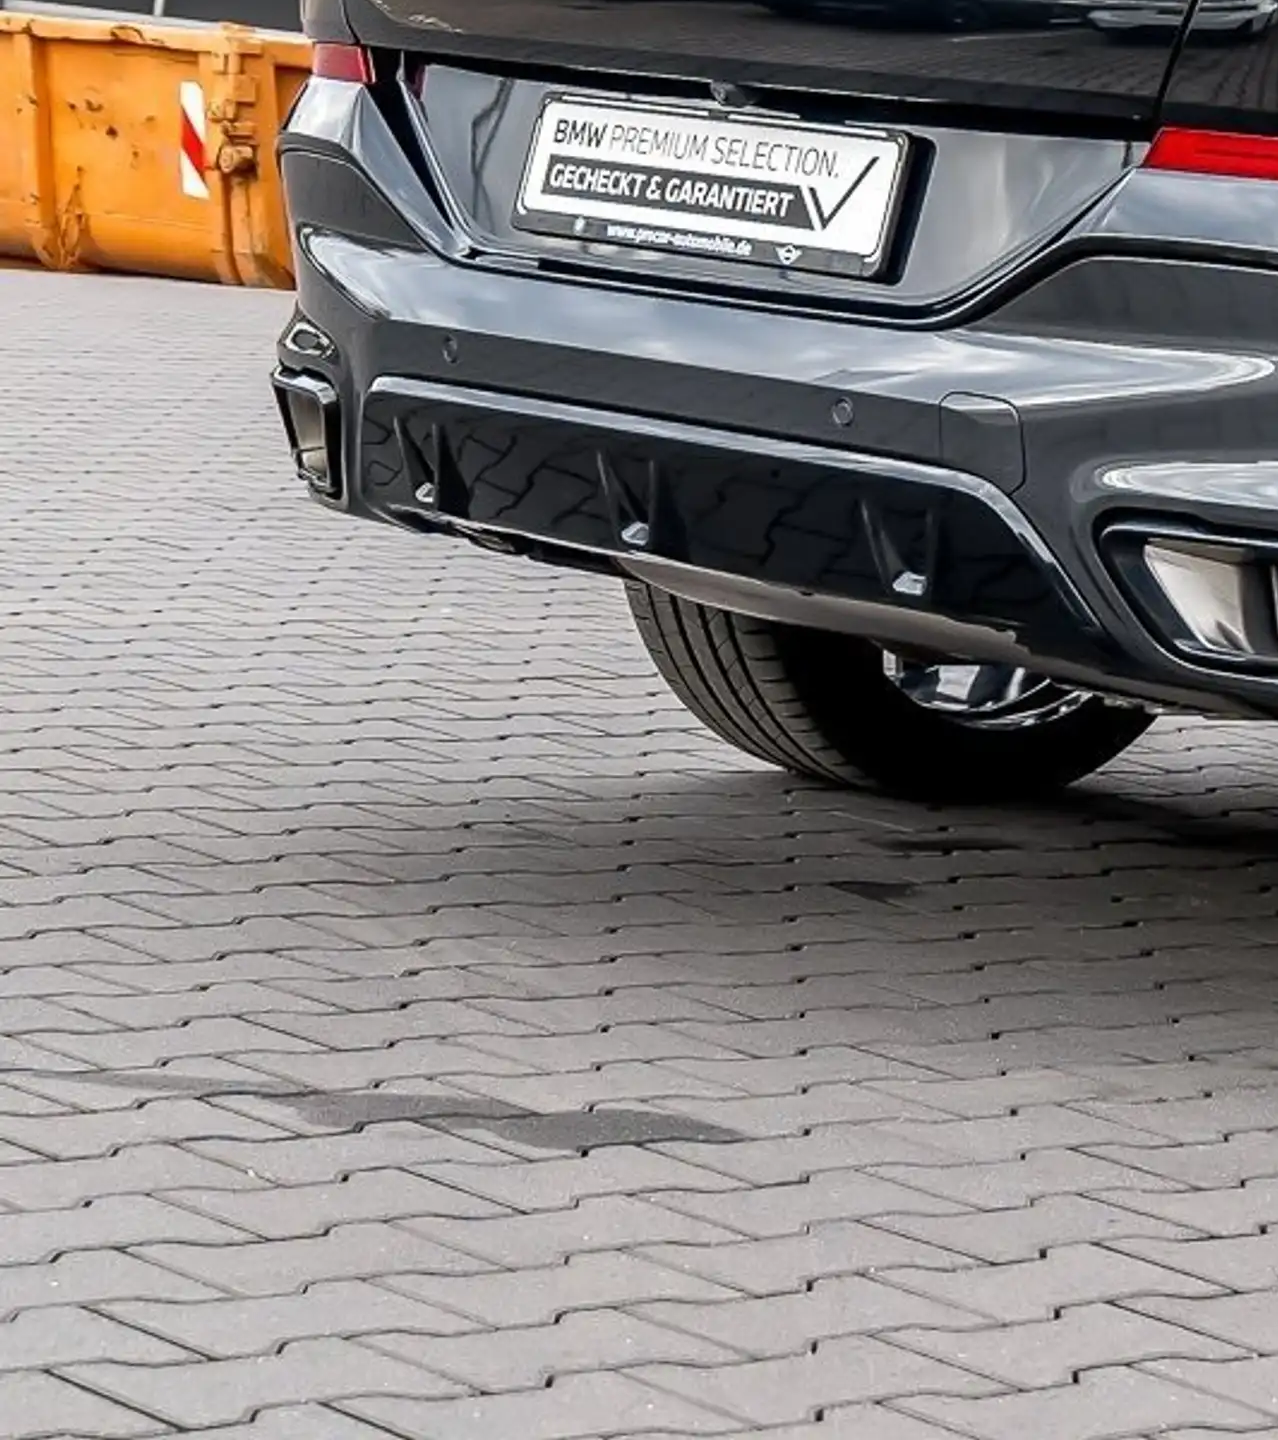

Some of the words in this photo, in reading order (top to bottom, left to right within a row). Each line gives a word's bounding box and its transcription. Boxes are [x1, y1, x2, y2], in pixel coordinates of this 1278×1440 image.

[553, 118, 608, 148] BMW
[610, 125, 708, 162] PREMIUM
[711, 136, 839, 178] SELECTION.
[550, 163, 646, 197] GECHECKT
[646, 178, 663, 201] &
[665, 178, 794, 217] GARANTIERT
